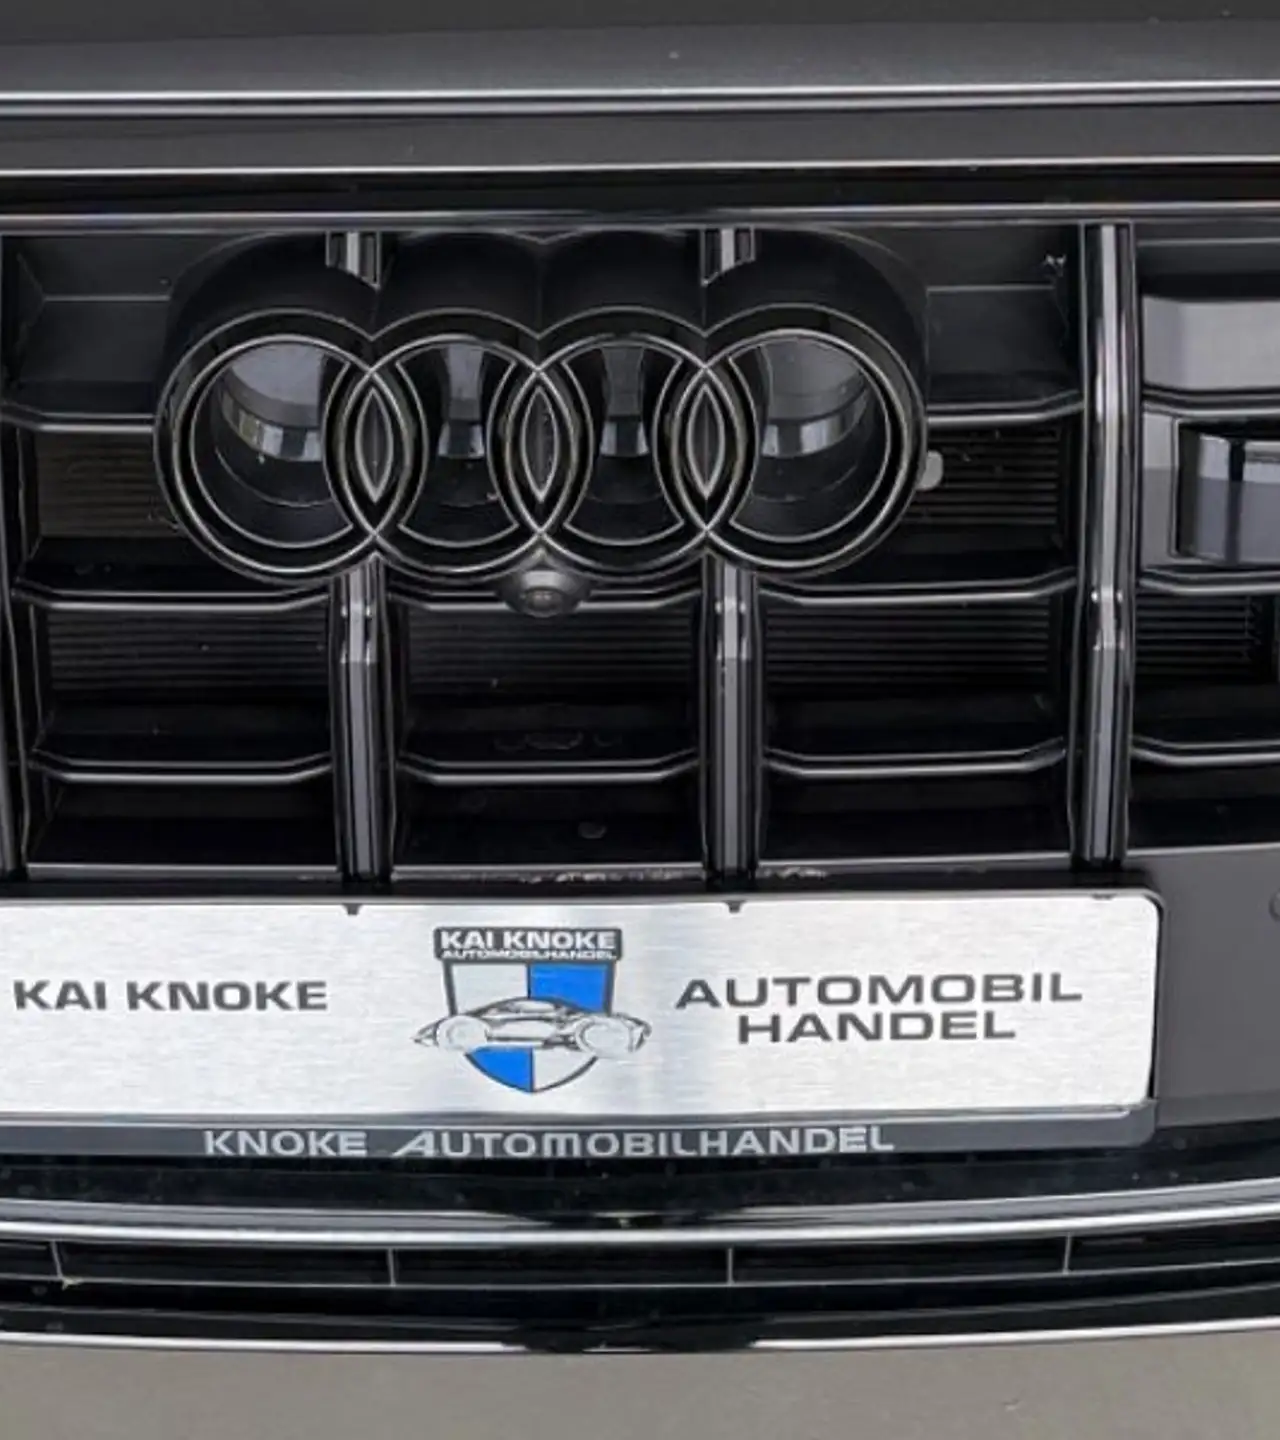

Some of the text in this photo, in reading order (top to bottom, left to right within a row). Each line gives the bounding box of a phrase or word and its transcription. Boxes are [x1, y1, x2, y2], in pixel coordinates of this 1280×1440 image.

[440, 930, 616, 949] KAI KNOKE
[13, 980, 328, 1011] KAI KNOKE
[675, 972, 1083, 1009] AUTOMOBIL
[737, 1010, 1017, 1045] HANDEL
[203, 1126, 895, 1158] KNOKE AUTOMOBILHANDEL
